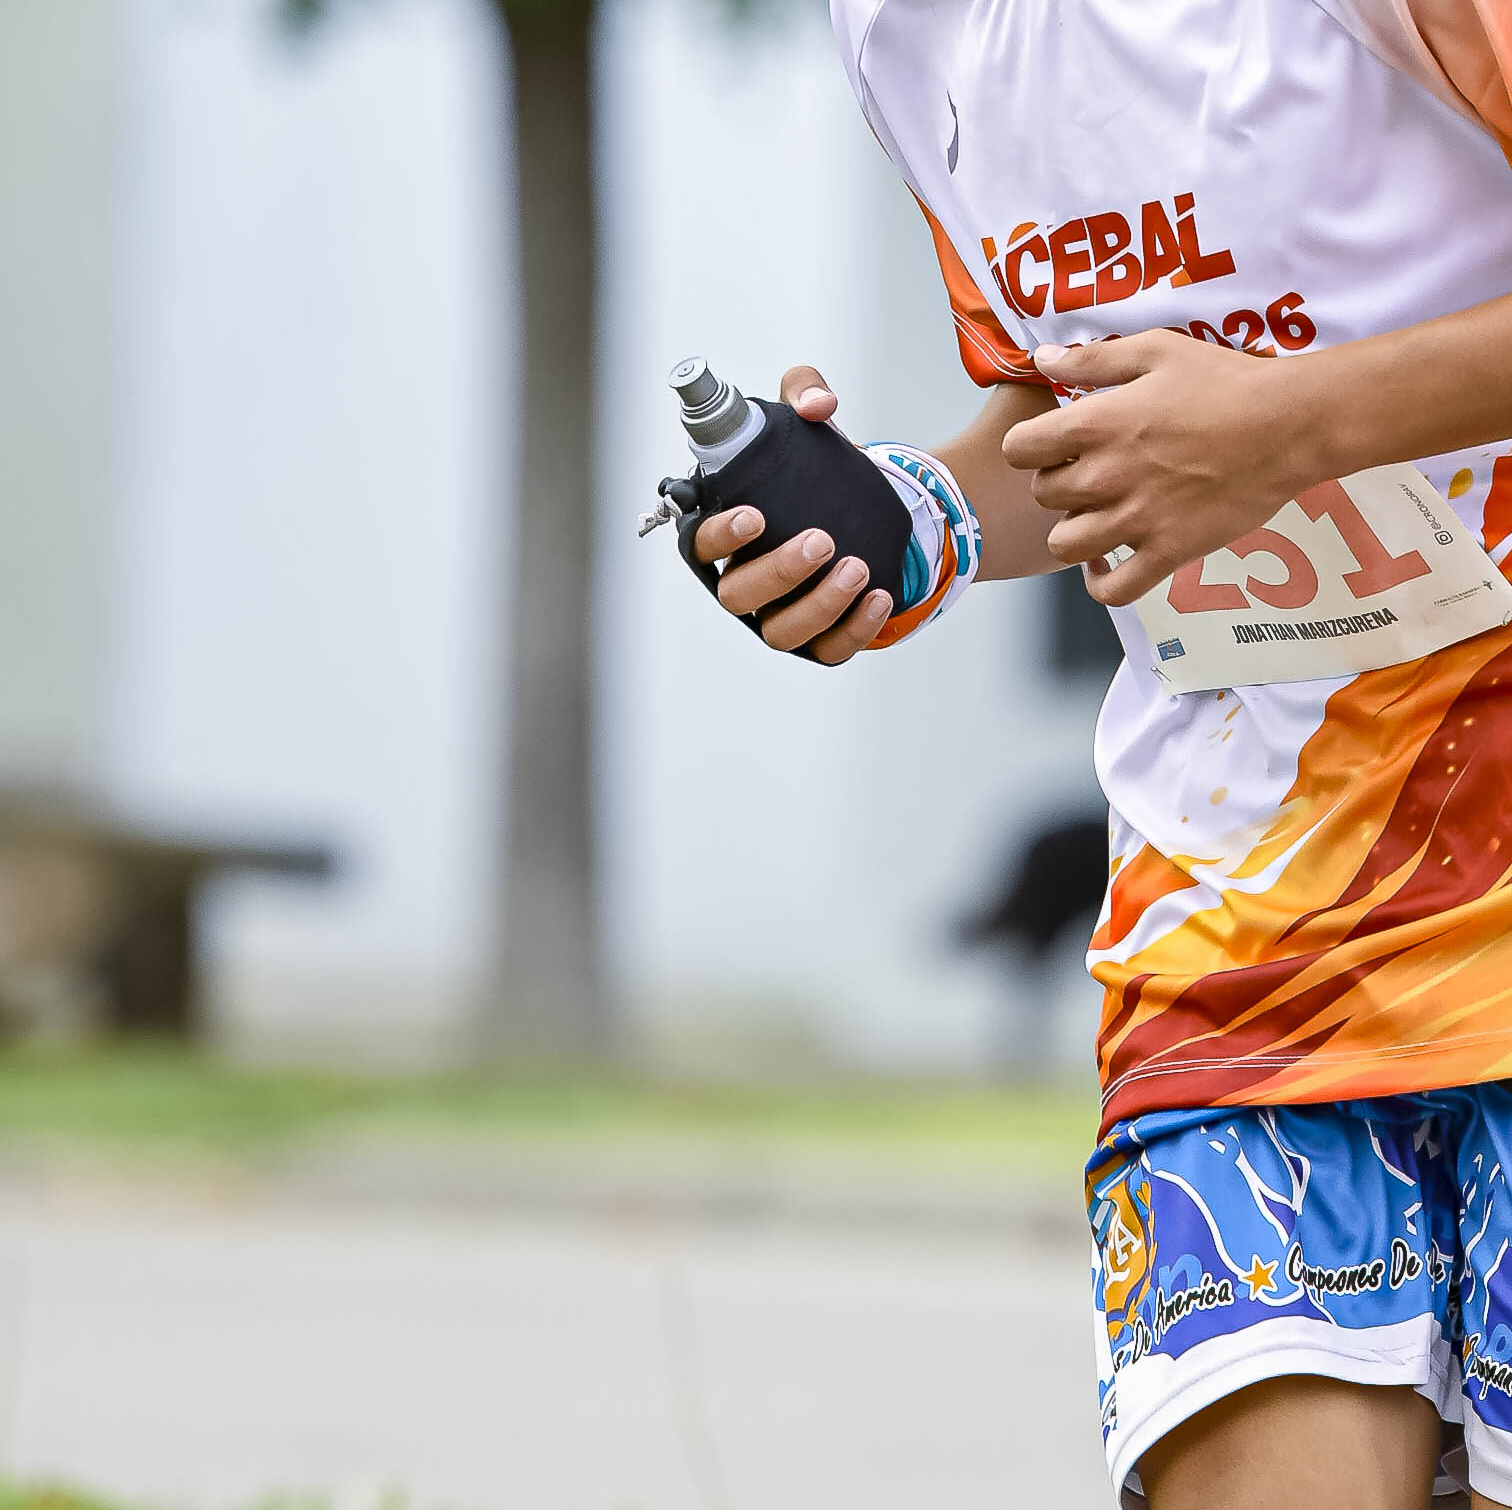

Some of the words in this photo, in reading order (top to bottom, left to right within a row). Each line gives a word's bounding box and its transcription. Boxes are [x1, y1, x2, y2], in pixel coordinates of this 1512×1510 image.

[1163, 292, 1317, 353] 26
[1232, 623, 1300, 644] JONATHAN
[1390, 1241, 1421, 1287] De
